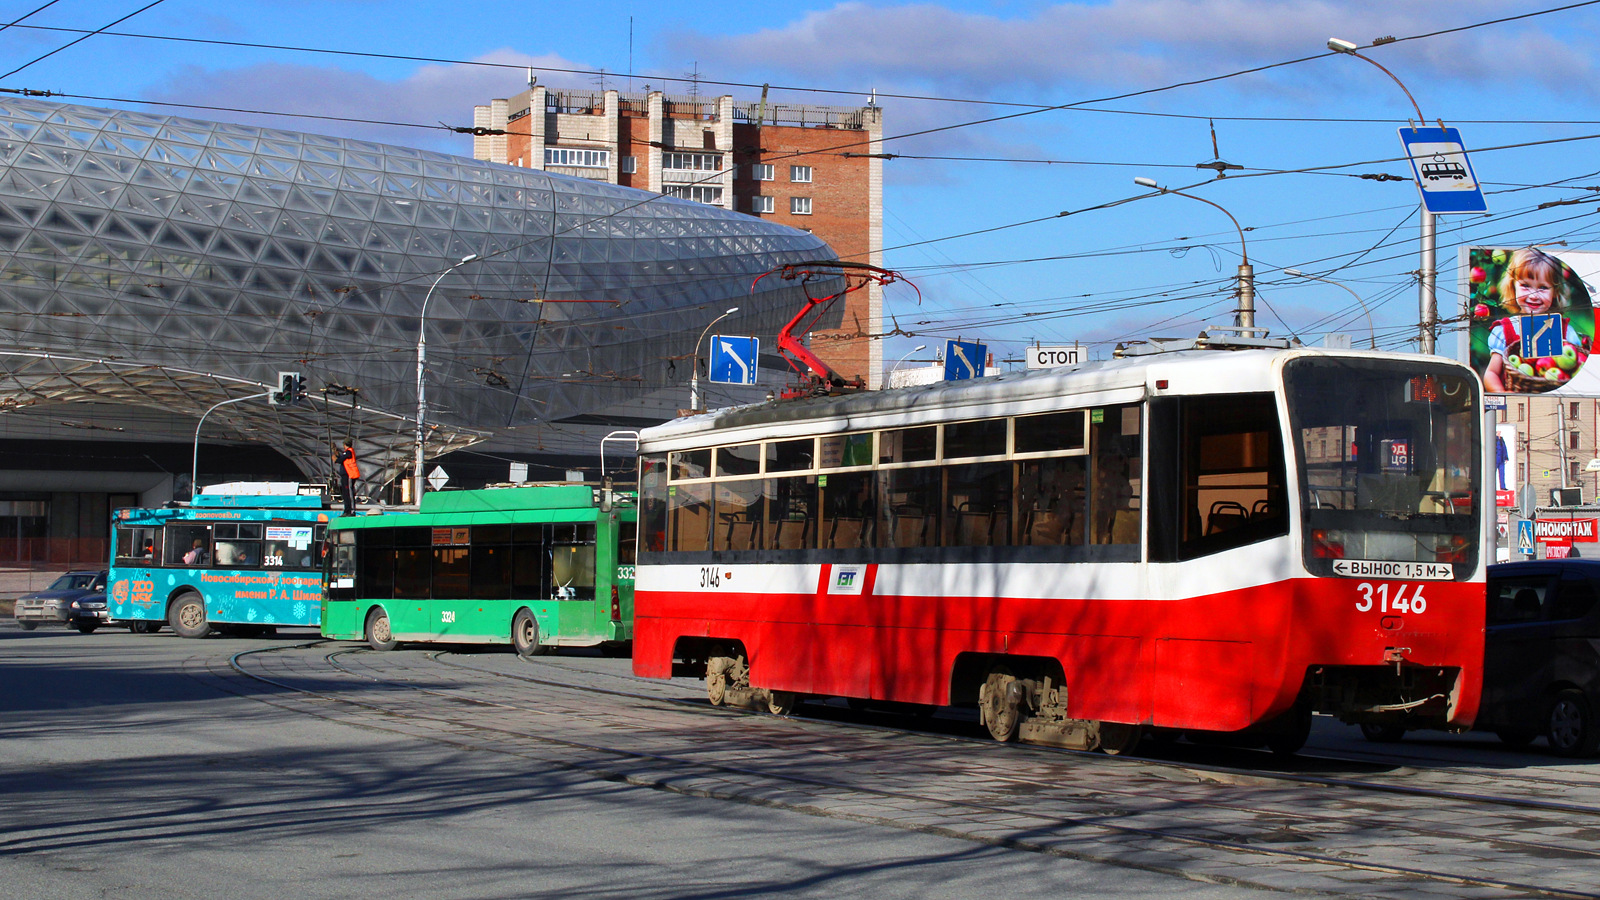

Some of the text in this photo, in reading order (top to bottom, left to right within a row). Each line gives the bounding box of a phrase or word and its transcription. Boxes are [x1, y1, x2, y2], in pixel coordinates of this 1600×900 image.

[1038, 351, 1078, 364] СТОП
[1411, 376, 1436, 402] 14
[263, 555, 284, 567] 3314
[1351, 562, 1436, 578] ВЫНОС 1,5 М
[201, 573, 279, 587] Новосибирскому
[700, 567, 720, 588] 3146
[132, 580, 154, 592] ZOO
[235, 589, 267, 599] имени
[269, 589, 278, 600] Р.
[280, 590, 290, 600] А.
[1355, 582, 1427, 614] 3146
[441, 610, 456, 623] 3324
